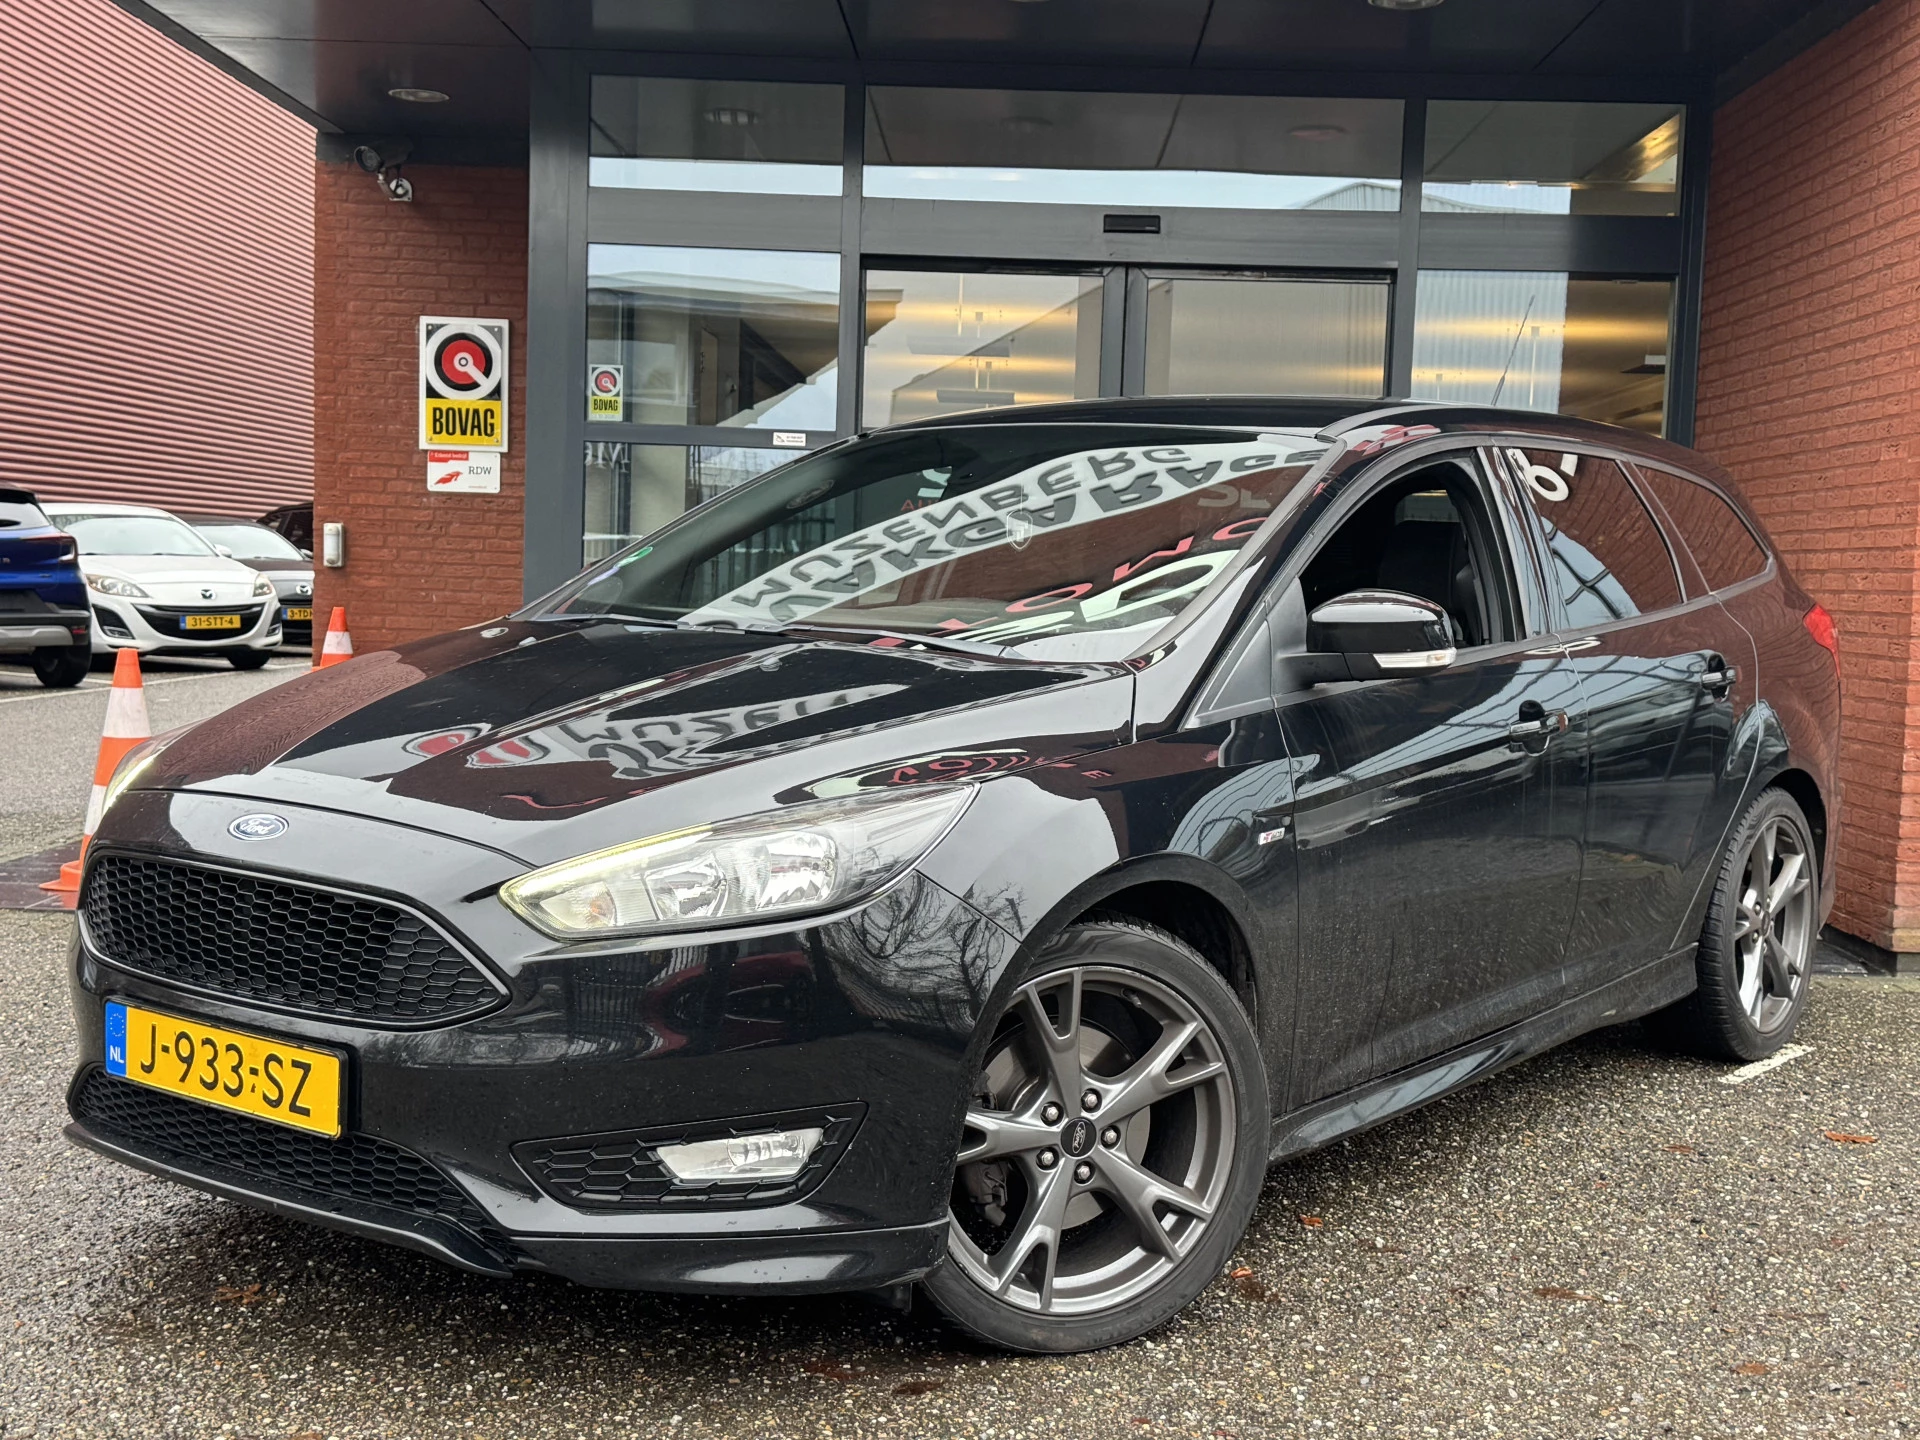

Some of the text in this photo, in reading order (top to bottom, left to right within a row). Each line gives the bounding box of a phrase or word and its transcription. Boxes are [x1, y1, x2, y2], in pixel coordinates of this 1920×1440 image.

[593, 399, 619, 412] BOVAG
[432, 407, 495, 437] BOVAG
[468, 465, 492, 475] RDW
[191, 616, 234, 627] 31-STT-4
[240, 818, 275, 835] Ford
[109, 1045, 124, 1064] NL
[140, 1023, 312, 1118] J-933-SZ
[1073, 1126, 1084, 1148] Ford
